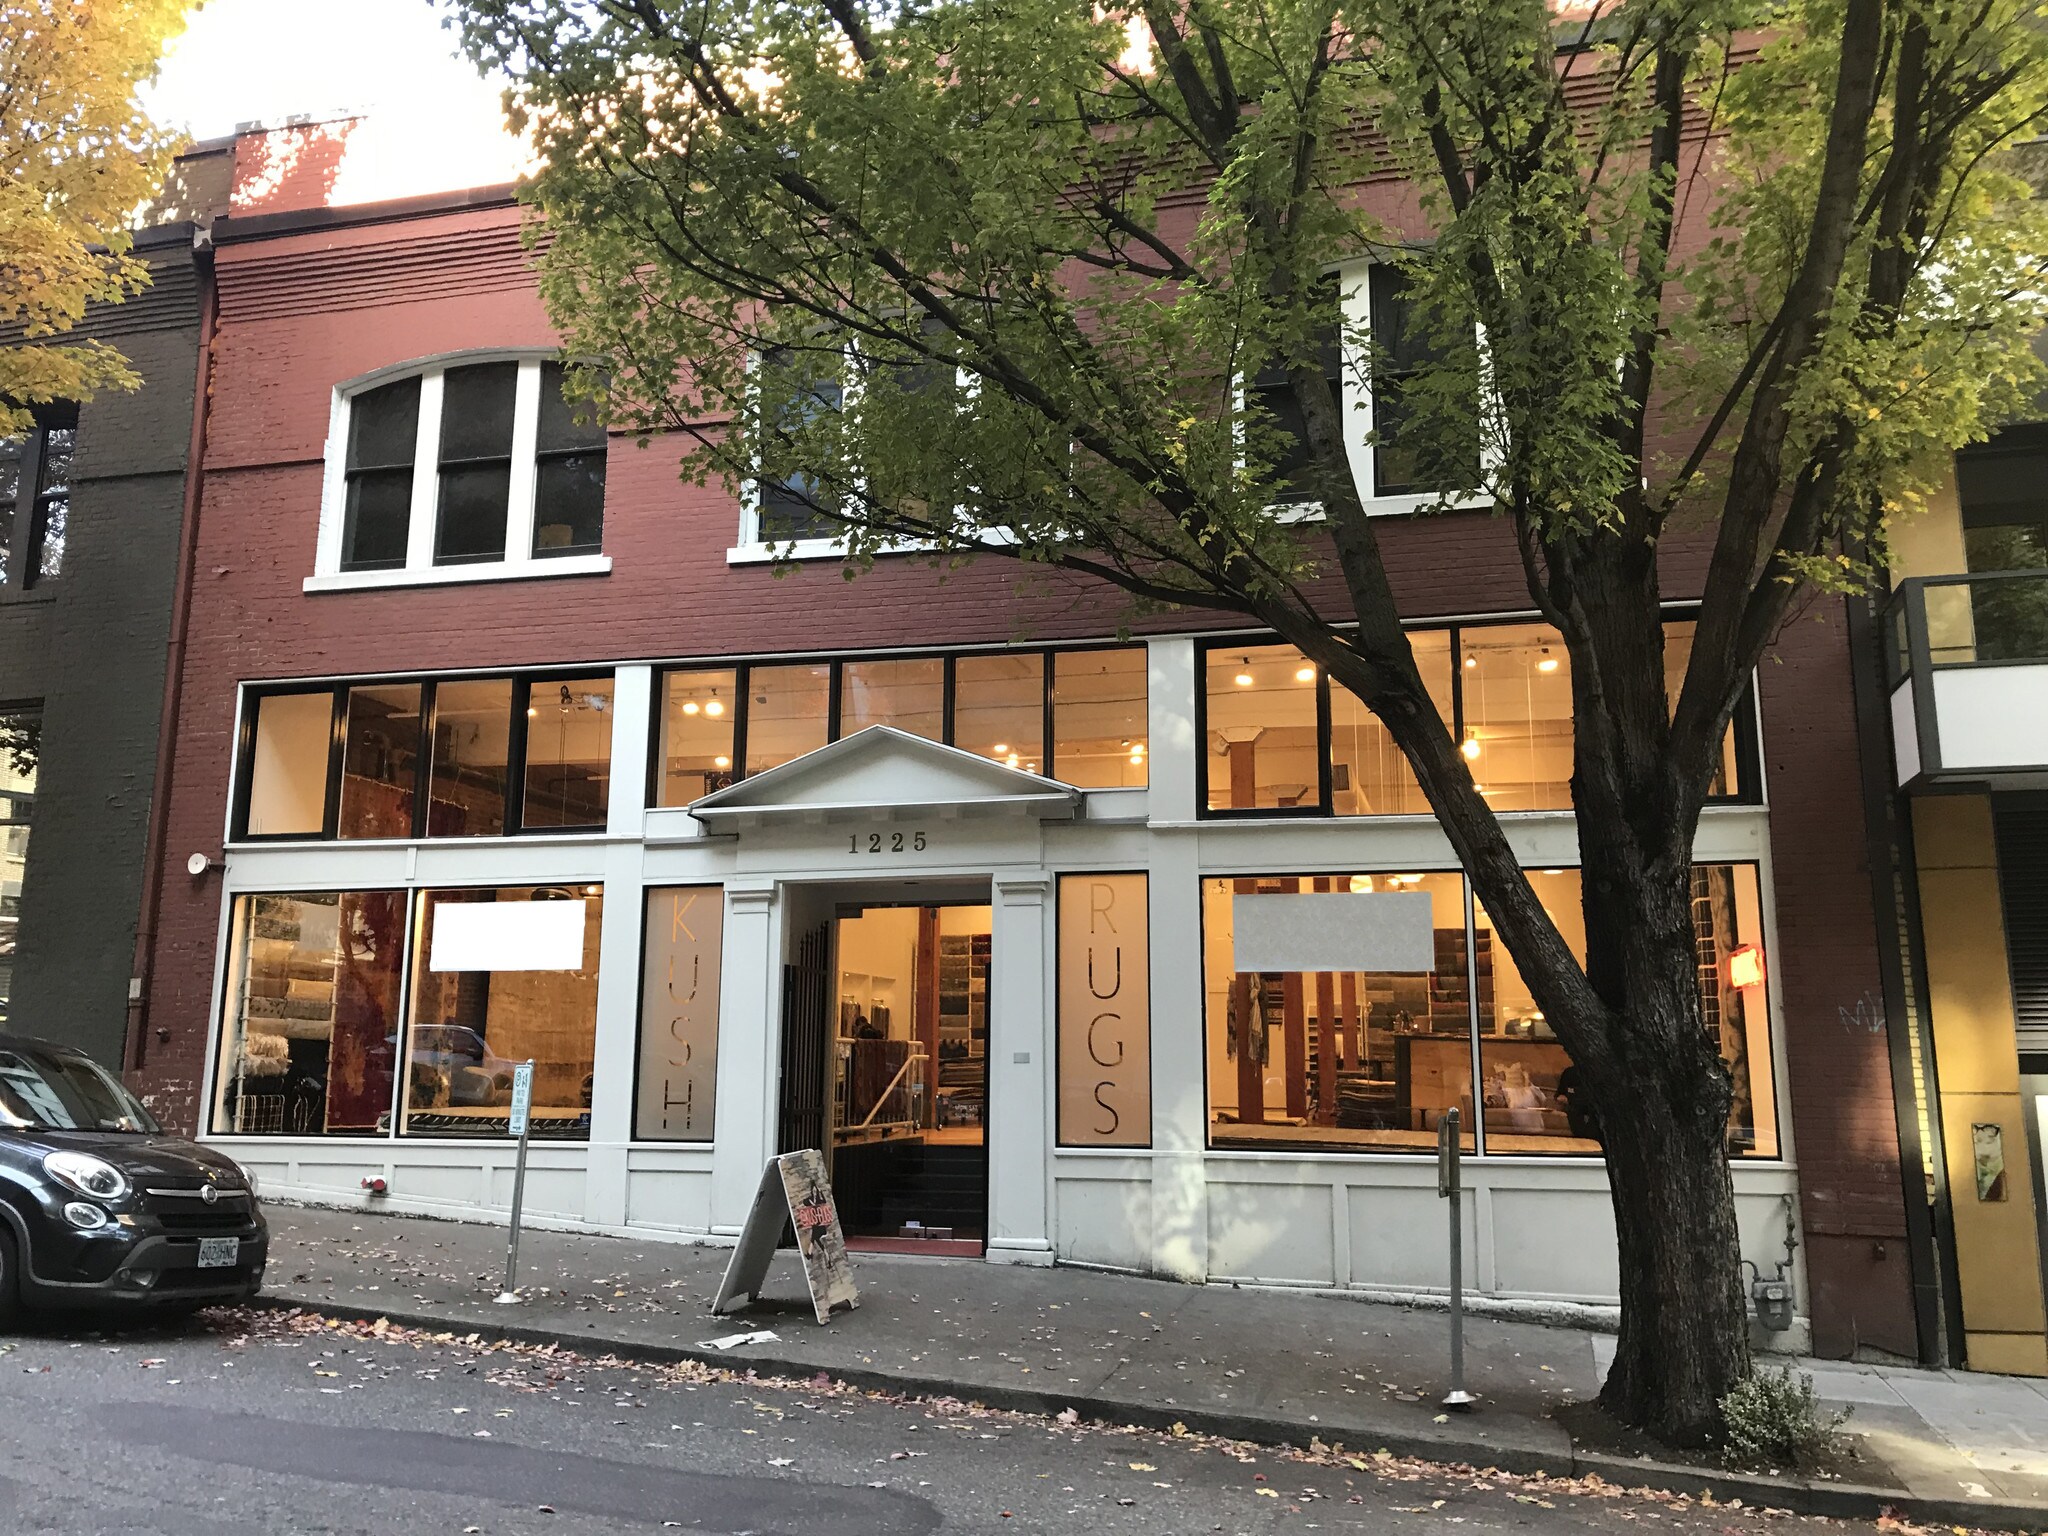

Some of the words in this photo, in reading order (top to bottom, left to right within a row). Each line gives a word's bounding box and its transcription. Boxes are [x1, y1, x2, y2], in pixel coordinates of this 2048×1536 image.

[848, 831, 927, 854] 1225
[662, 894, 699, 1130] KUSH
[1087, 882, 1123, 1135] RUGS
